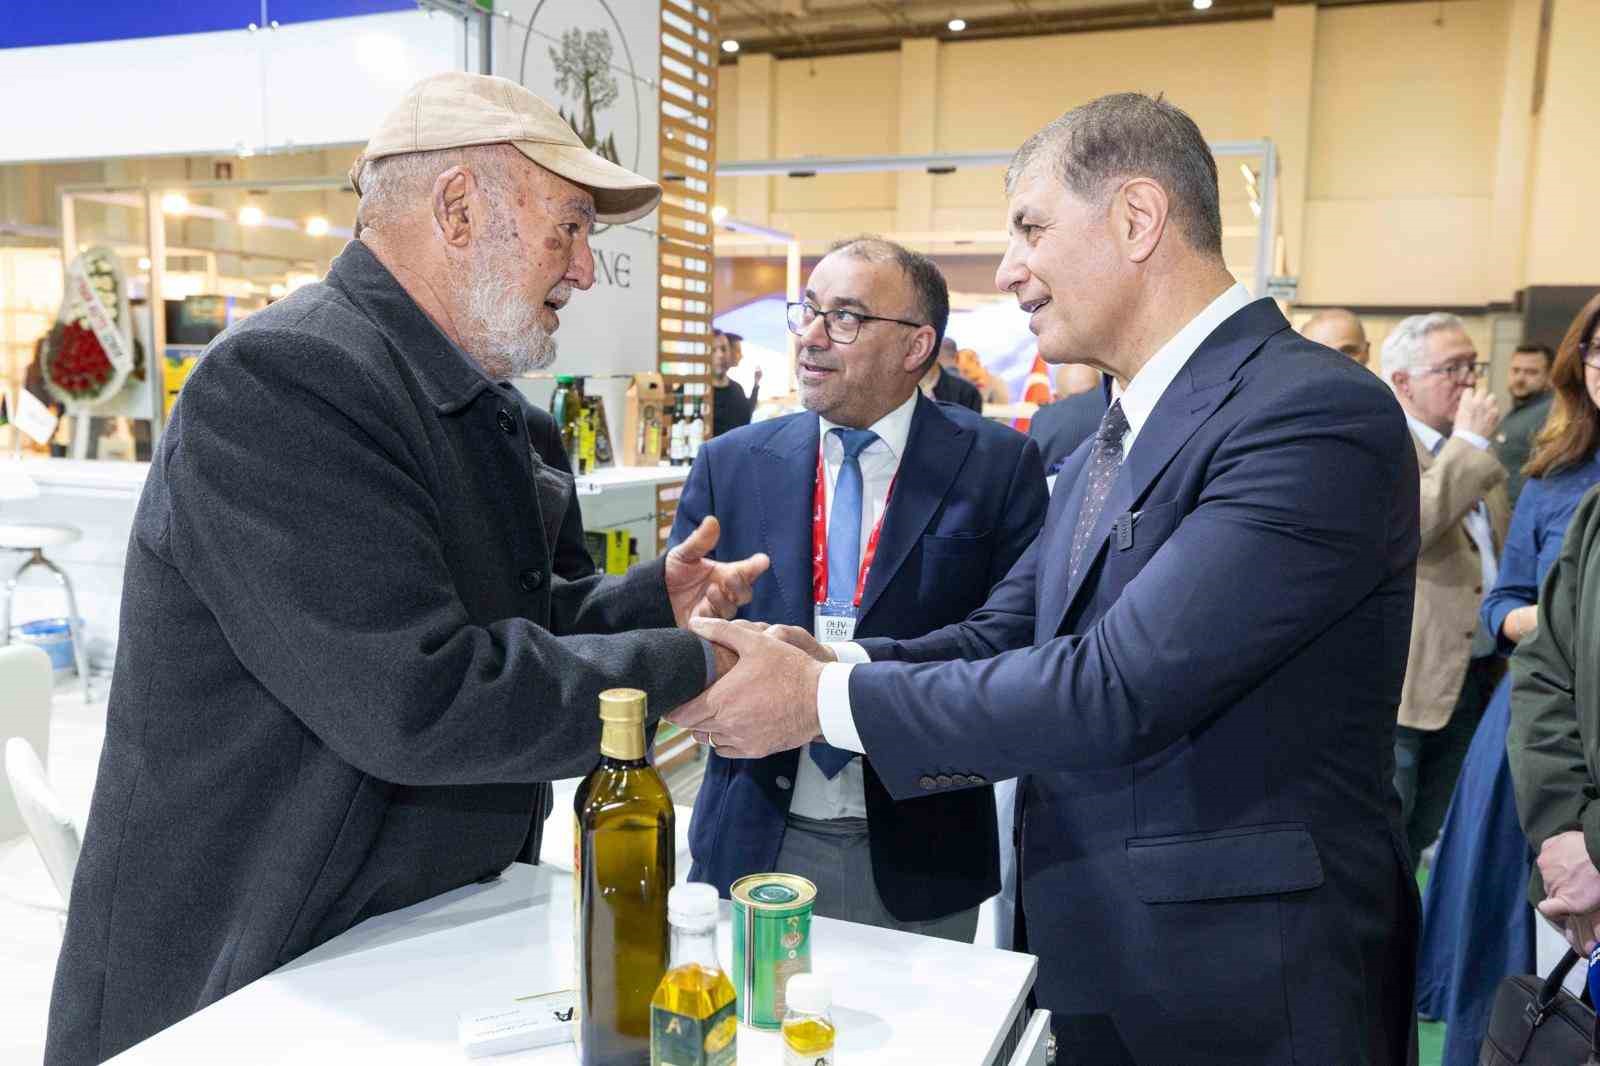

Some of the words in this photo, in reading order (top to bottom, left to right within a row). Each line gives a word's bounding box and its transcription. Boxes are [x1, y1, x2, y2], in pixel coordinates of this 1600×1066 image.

[593, 249, 631, 288] NE
[825, 619, 847, 629] OLIV
[825, 628, 847, 637] TECH
